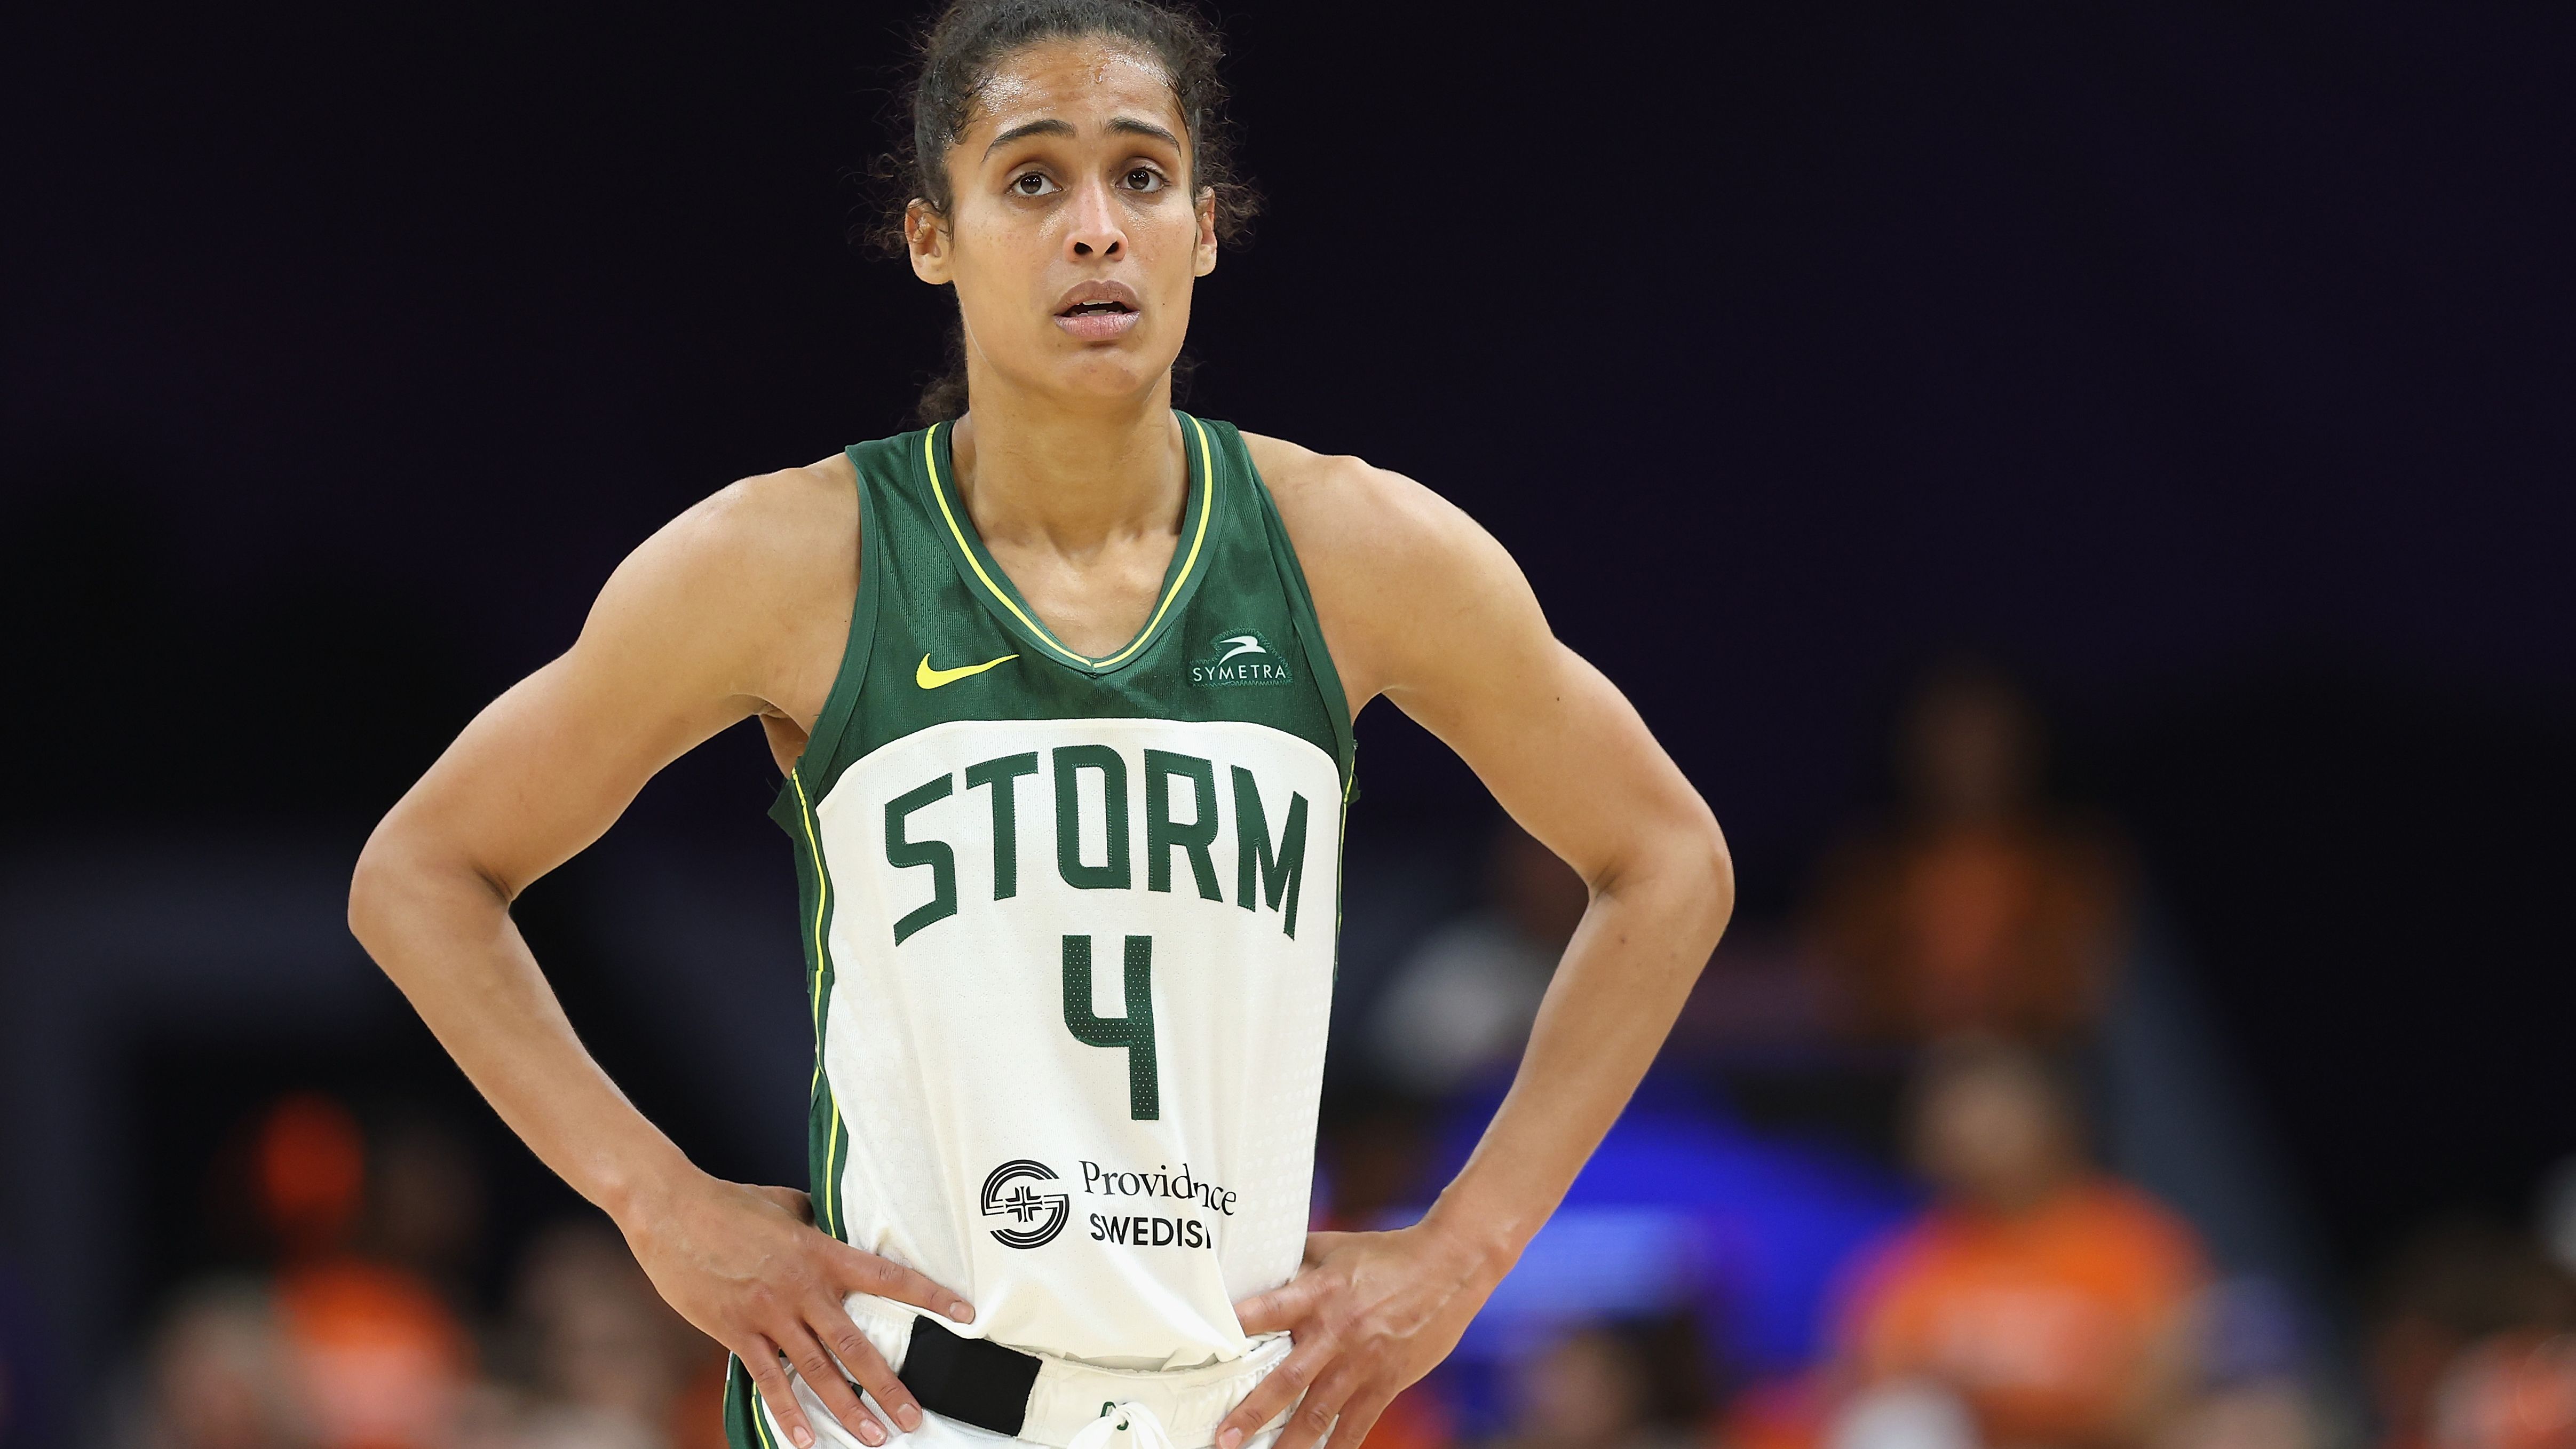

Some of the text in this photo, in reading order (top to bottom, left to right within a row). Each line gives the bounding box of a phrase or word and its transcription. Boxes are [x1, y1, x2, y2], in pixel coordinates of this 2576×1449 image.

[1192, 665, 1287, 682] SYMETRA
[884, 745, 1308, 946] STORM
[1062, 935, 1160, 1120] 4
[1079, 1160, 1237, 1216] Providnce
